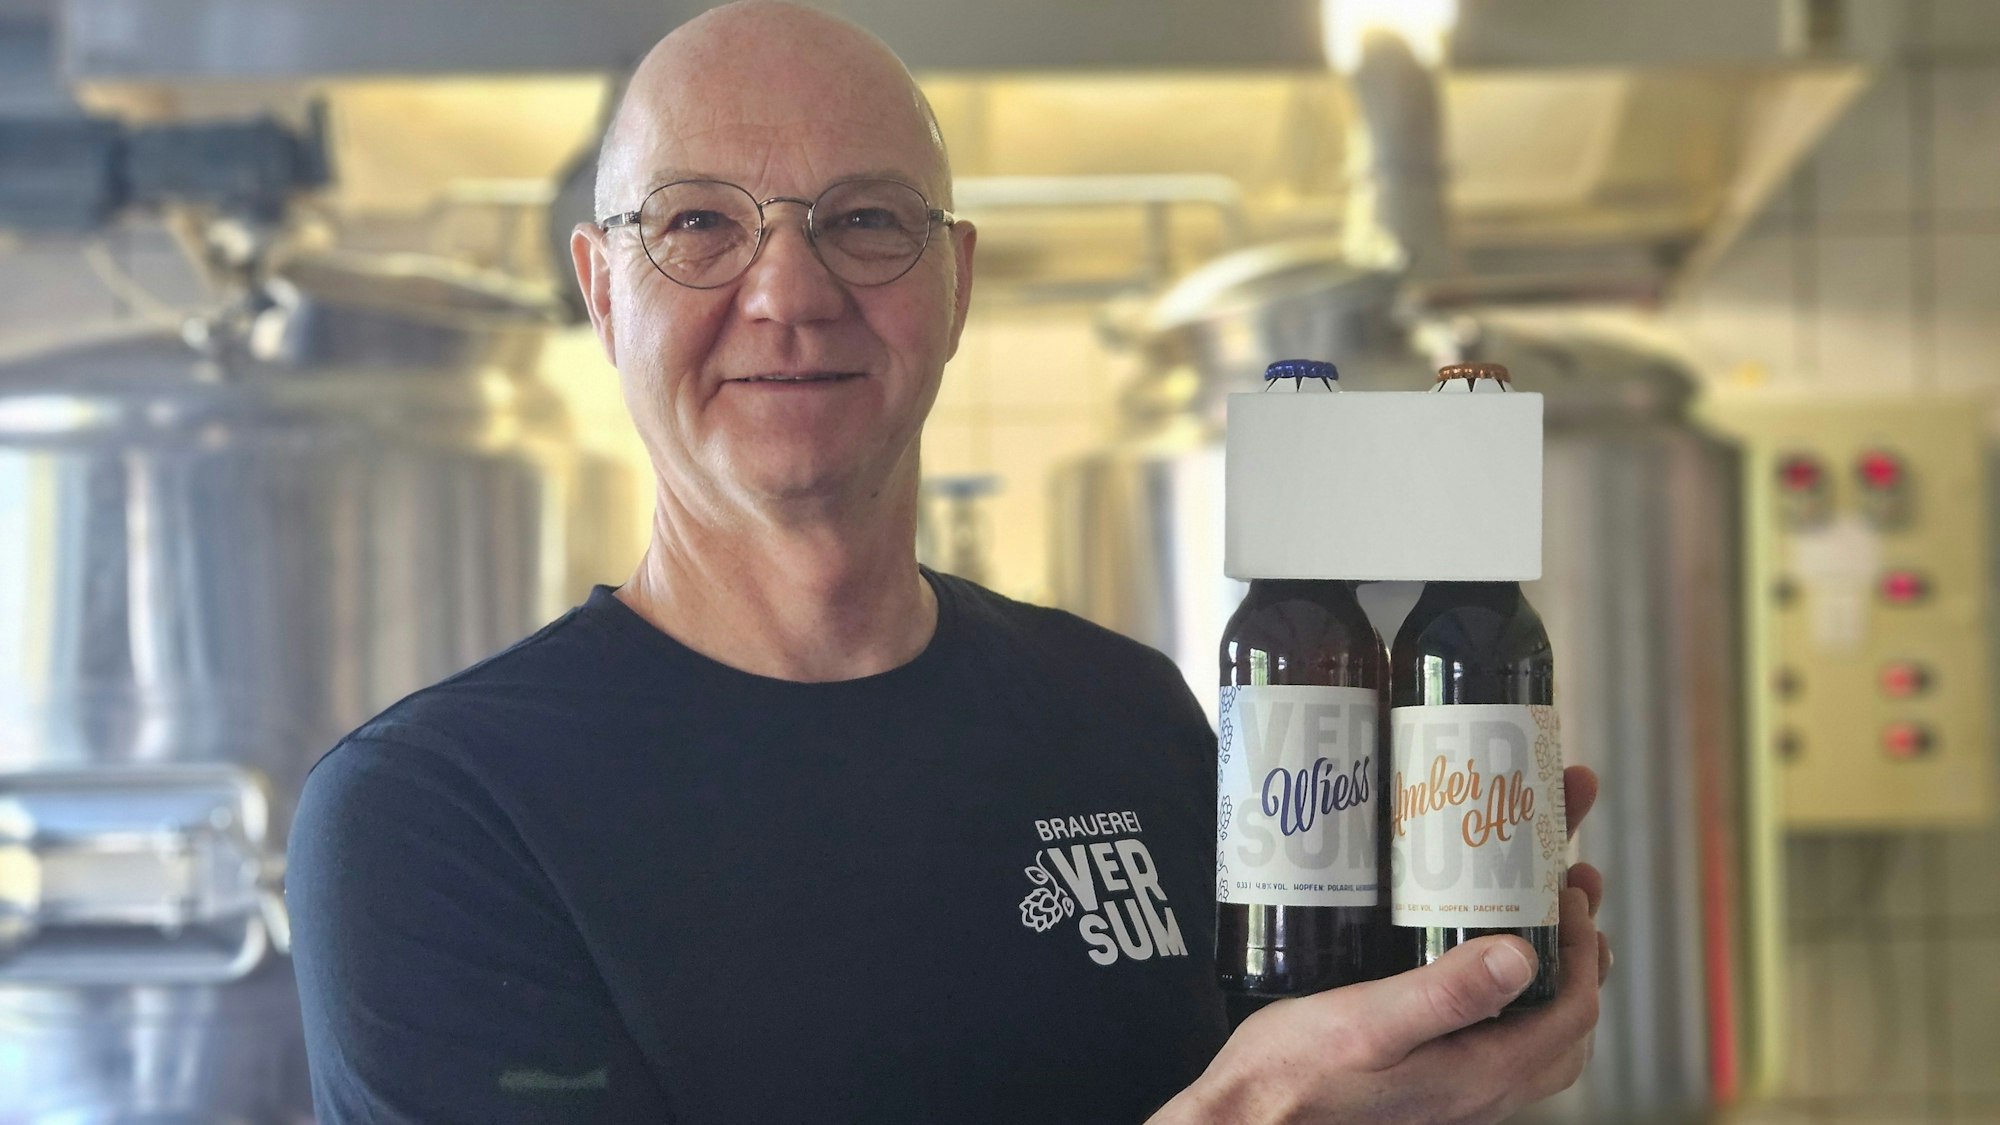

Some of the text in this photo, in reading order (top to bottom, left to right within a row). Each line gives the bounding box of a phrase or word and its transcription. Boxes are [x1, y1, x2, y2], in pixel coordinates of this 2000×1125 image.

[1035, 811, 1142, 841] BRAUEREI
[1262, 756, 1370, 836] Wiess
[1462, 770, 1535, 848] Ale
[1047, 839, 1168, 912] VER
[1079, 899, 1188, 966] SUM
